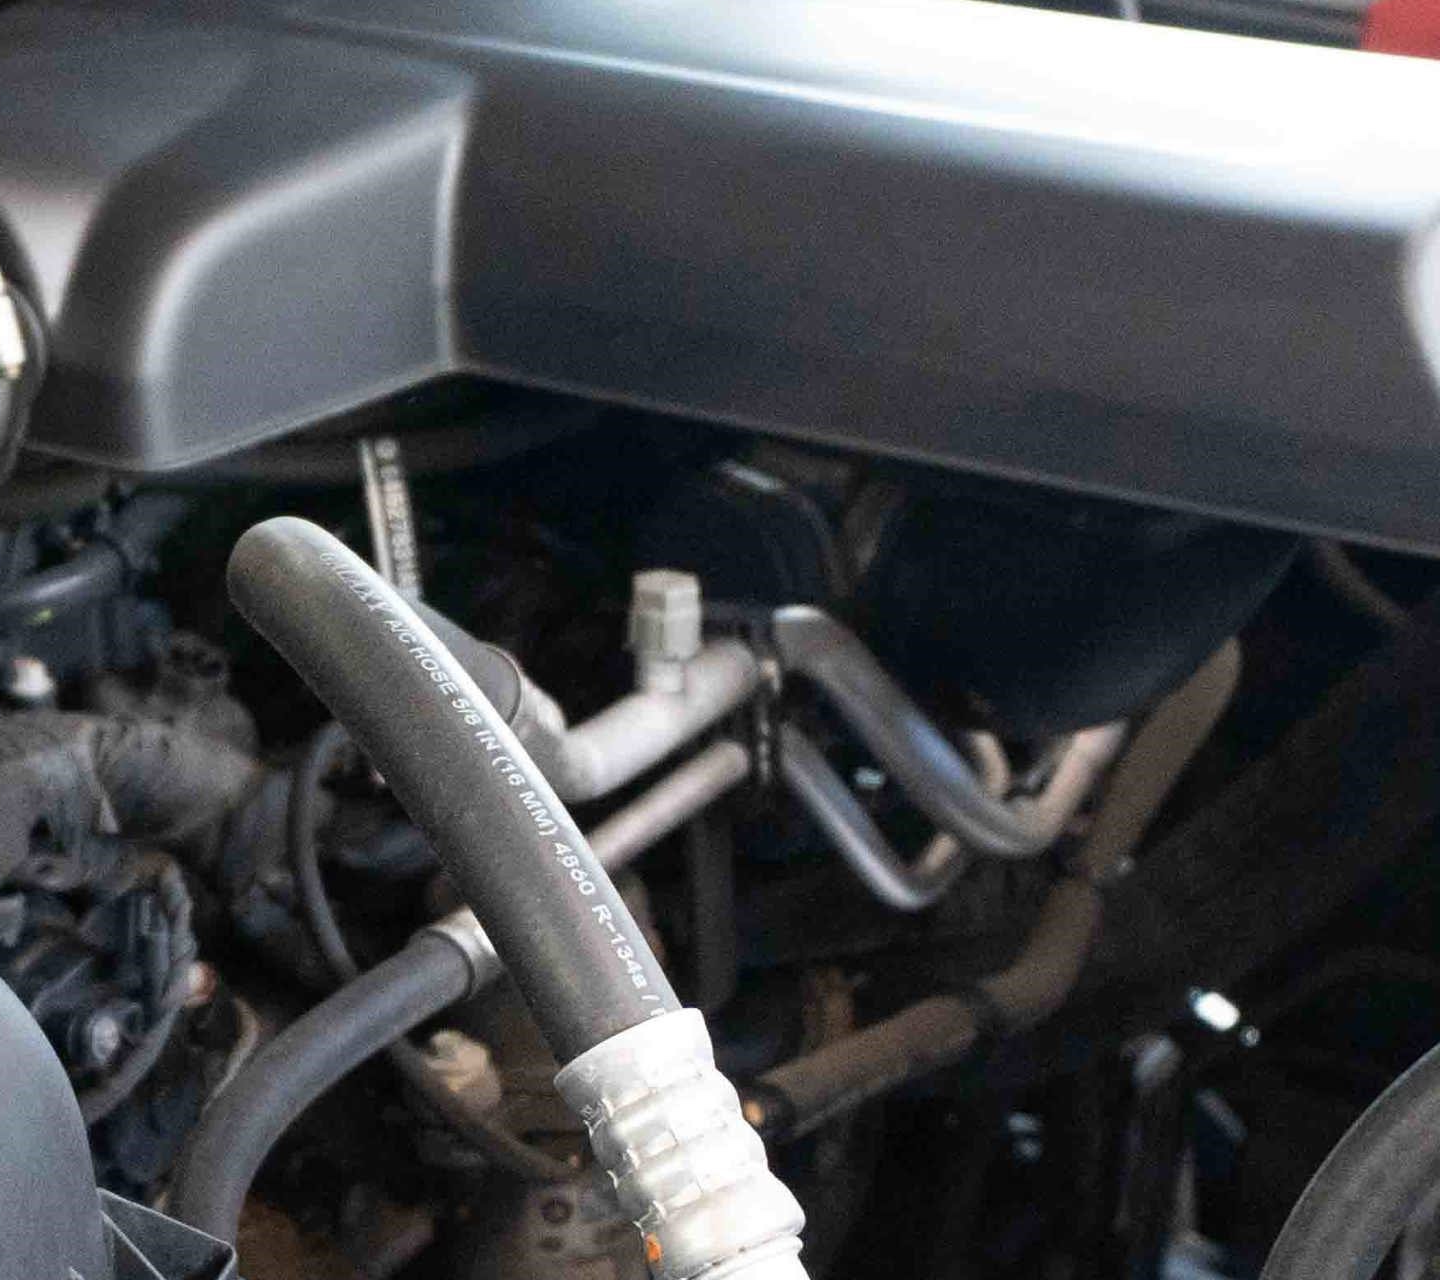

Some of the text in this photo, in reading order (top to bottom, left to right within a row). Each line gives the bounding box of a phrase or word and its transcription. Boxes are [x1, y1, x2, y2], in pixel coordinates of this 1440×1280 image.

[383, 618, 417, 647] A/C
[408, 646, 460, 696] HOSE
[451, 697, 481, 726] 5/8
[474, 728, 503, 752] IN
[491, 754, 527, 787] (16
[518, 789, 558, 836] MM)
[554, 841, 596, 896] 4860
[591, 904, 649, 989] R-134a
